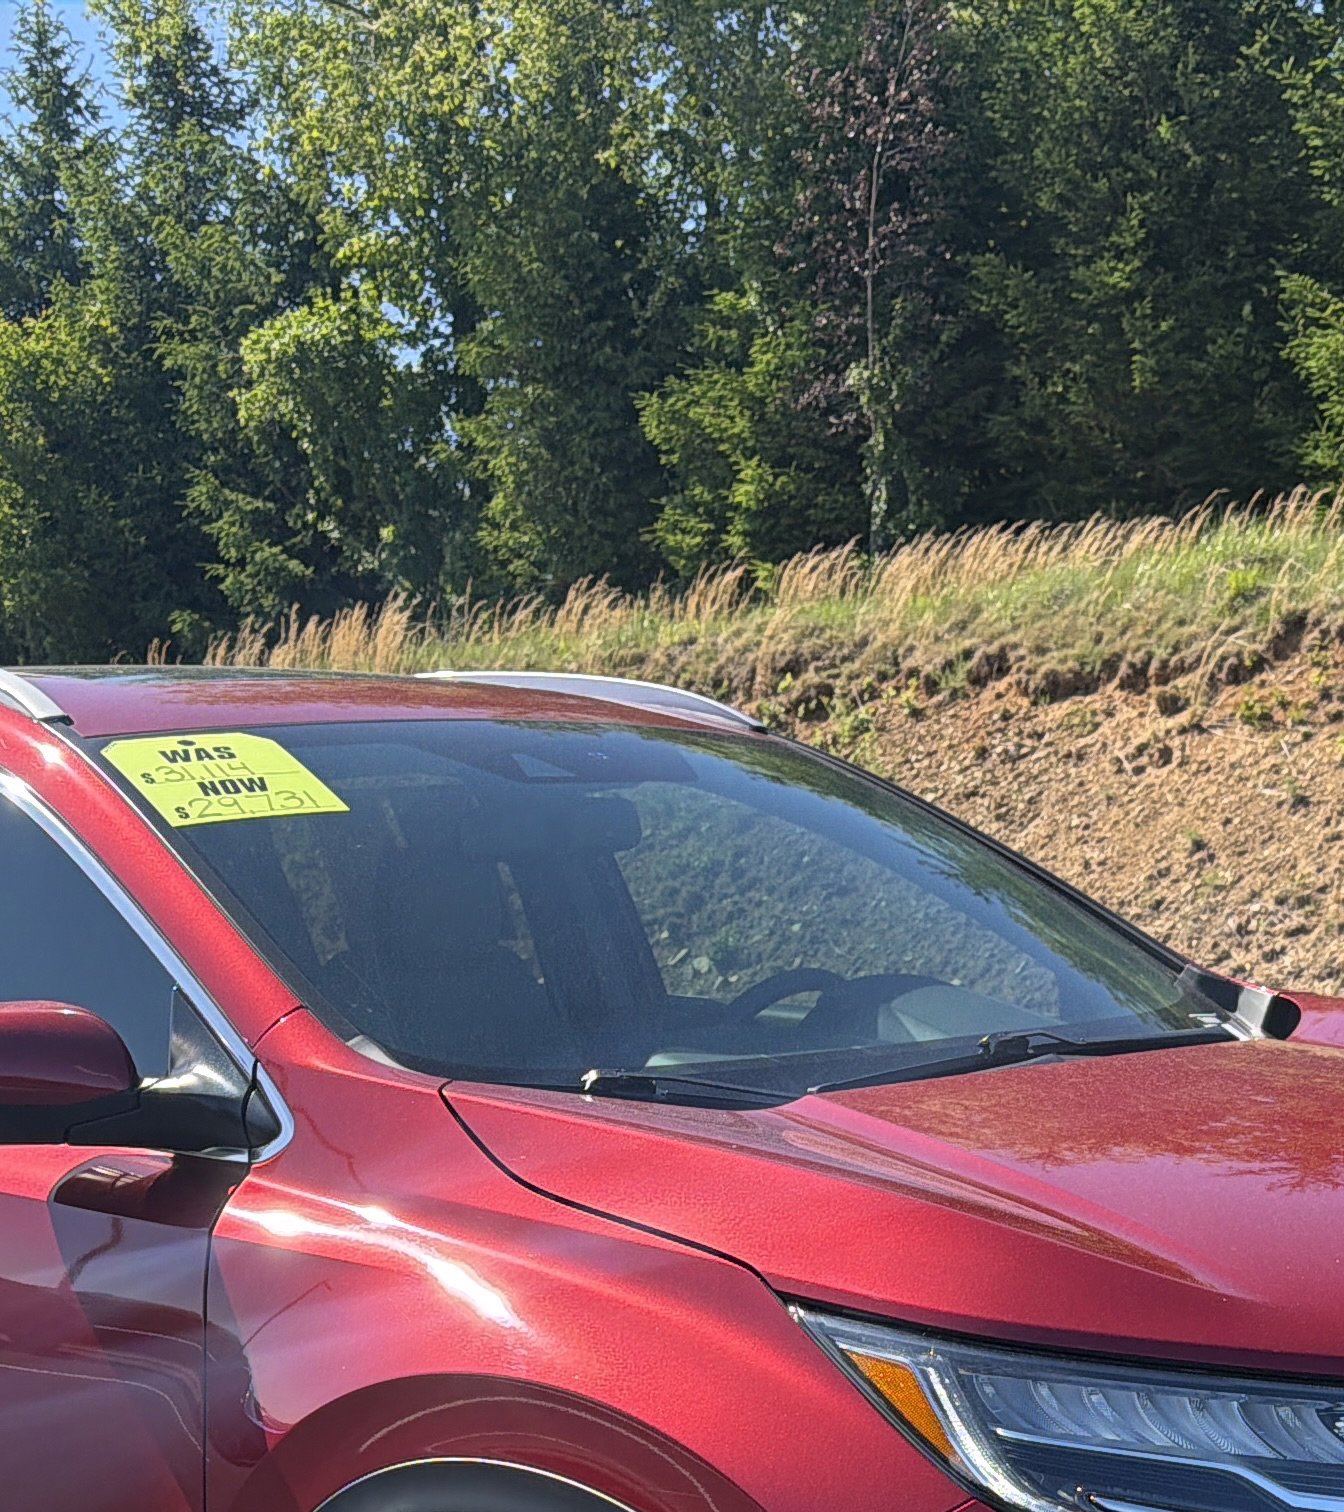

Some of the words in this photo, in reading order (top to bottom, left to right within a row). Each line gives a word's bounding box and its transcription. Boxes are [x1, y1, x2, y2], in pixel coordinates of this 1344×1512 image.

[158, 746, 237, 763] WAS
[197, 777, 268, 797] NOW
[174, 790, 321, 820] $29,731
